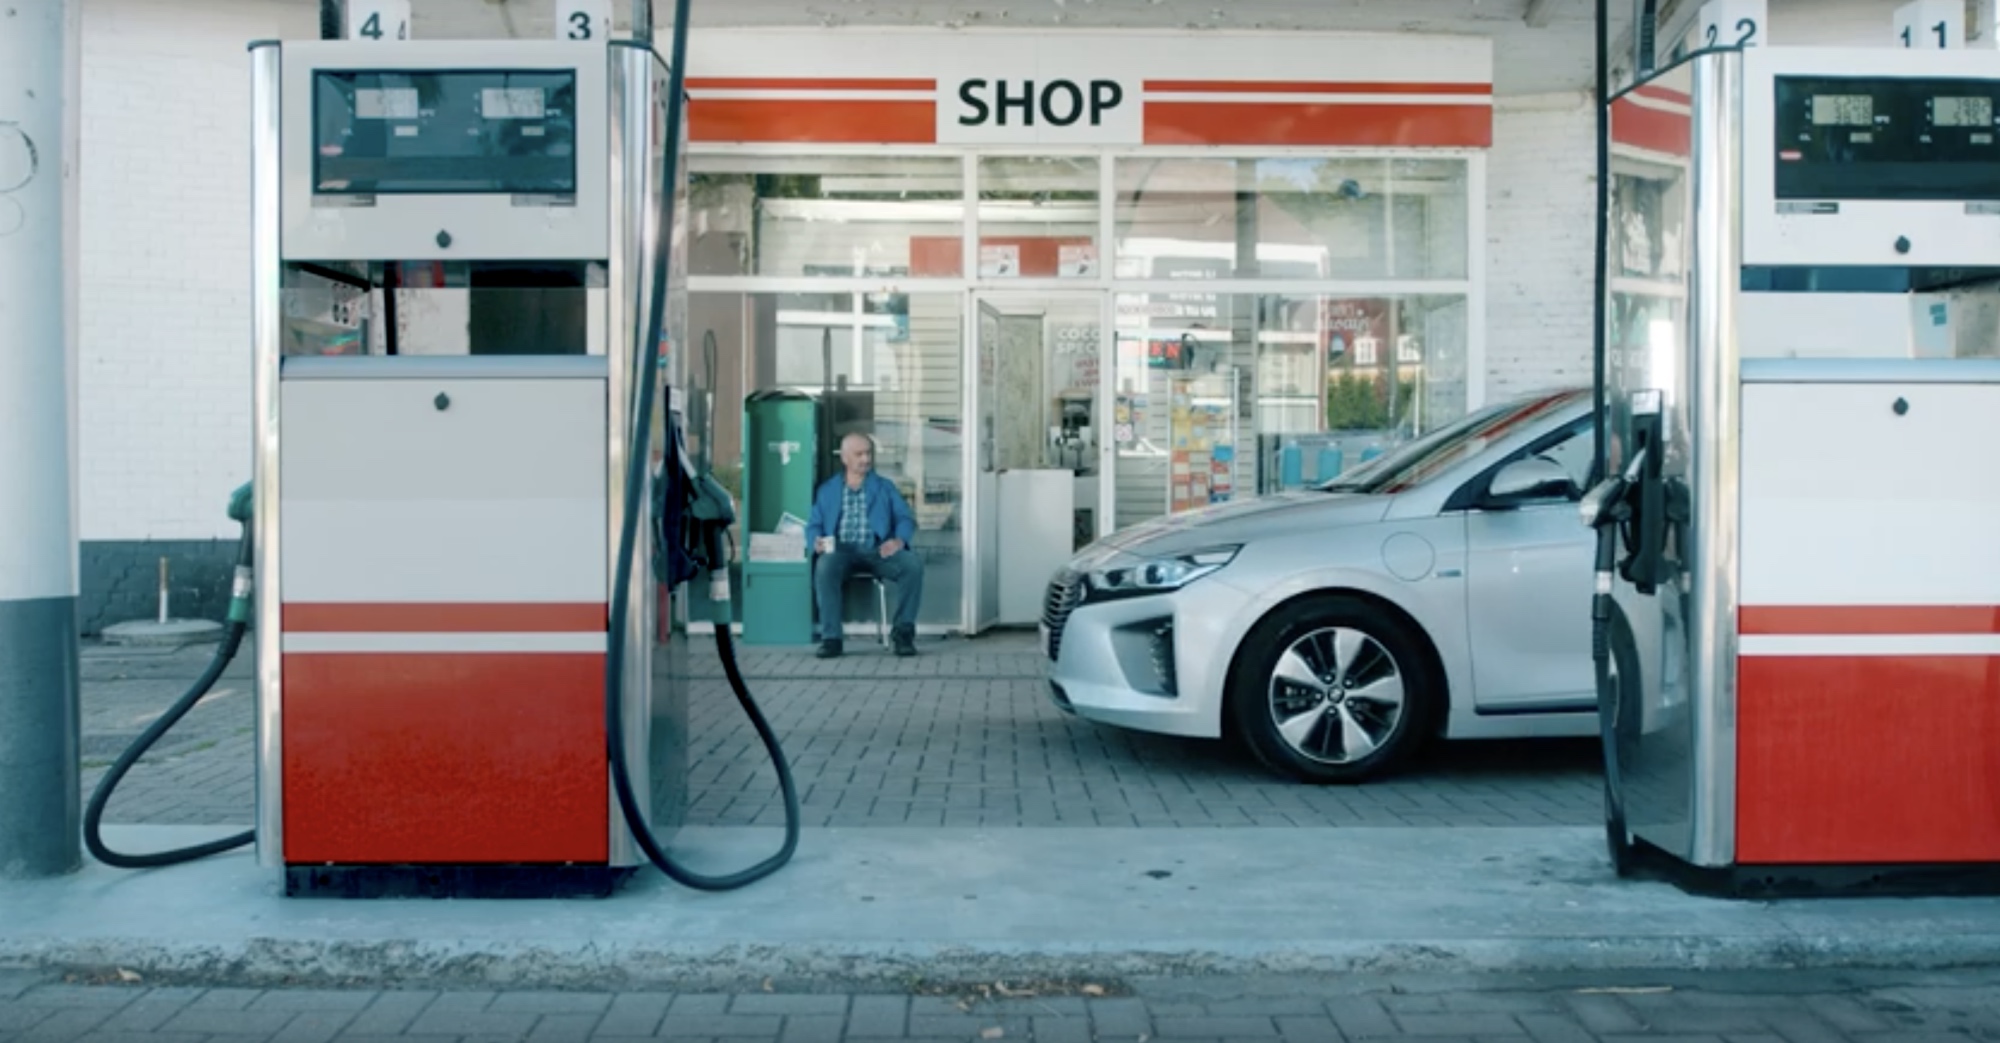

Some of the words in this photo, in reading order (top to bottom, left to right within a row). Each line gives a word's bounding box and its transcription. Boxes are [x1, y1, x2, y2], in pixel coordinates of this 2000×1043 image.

[360, 11, 384, 40] 4
[568, 11, 591, 40] 3
[1735, 18, 1757, 48] 2
[1901, 25, 1911, 48] 1
[1931, 20, 1946, 49] 1
[958, 78, 1123, 126] SHOP
